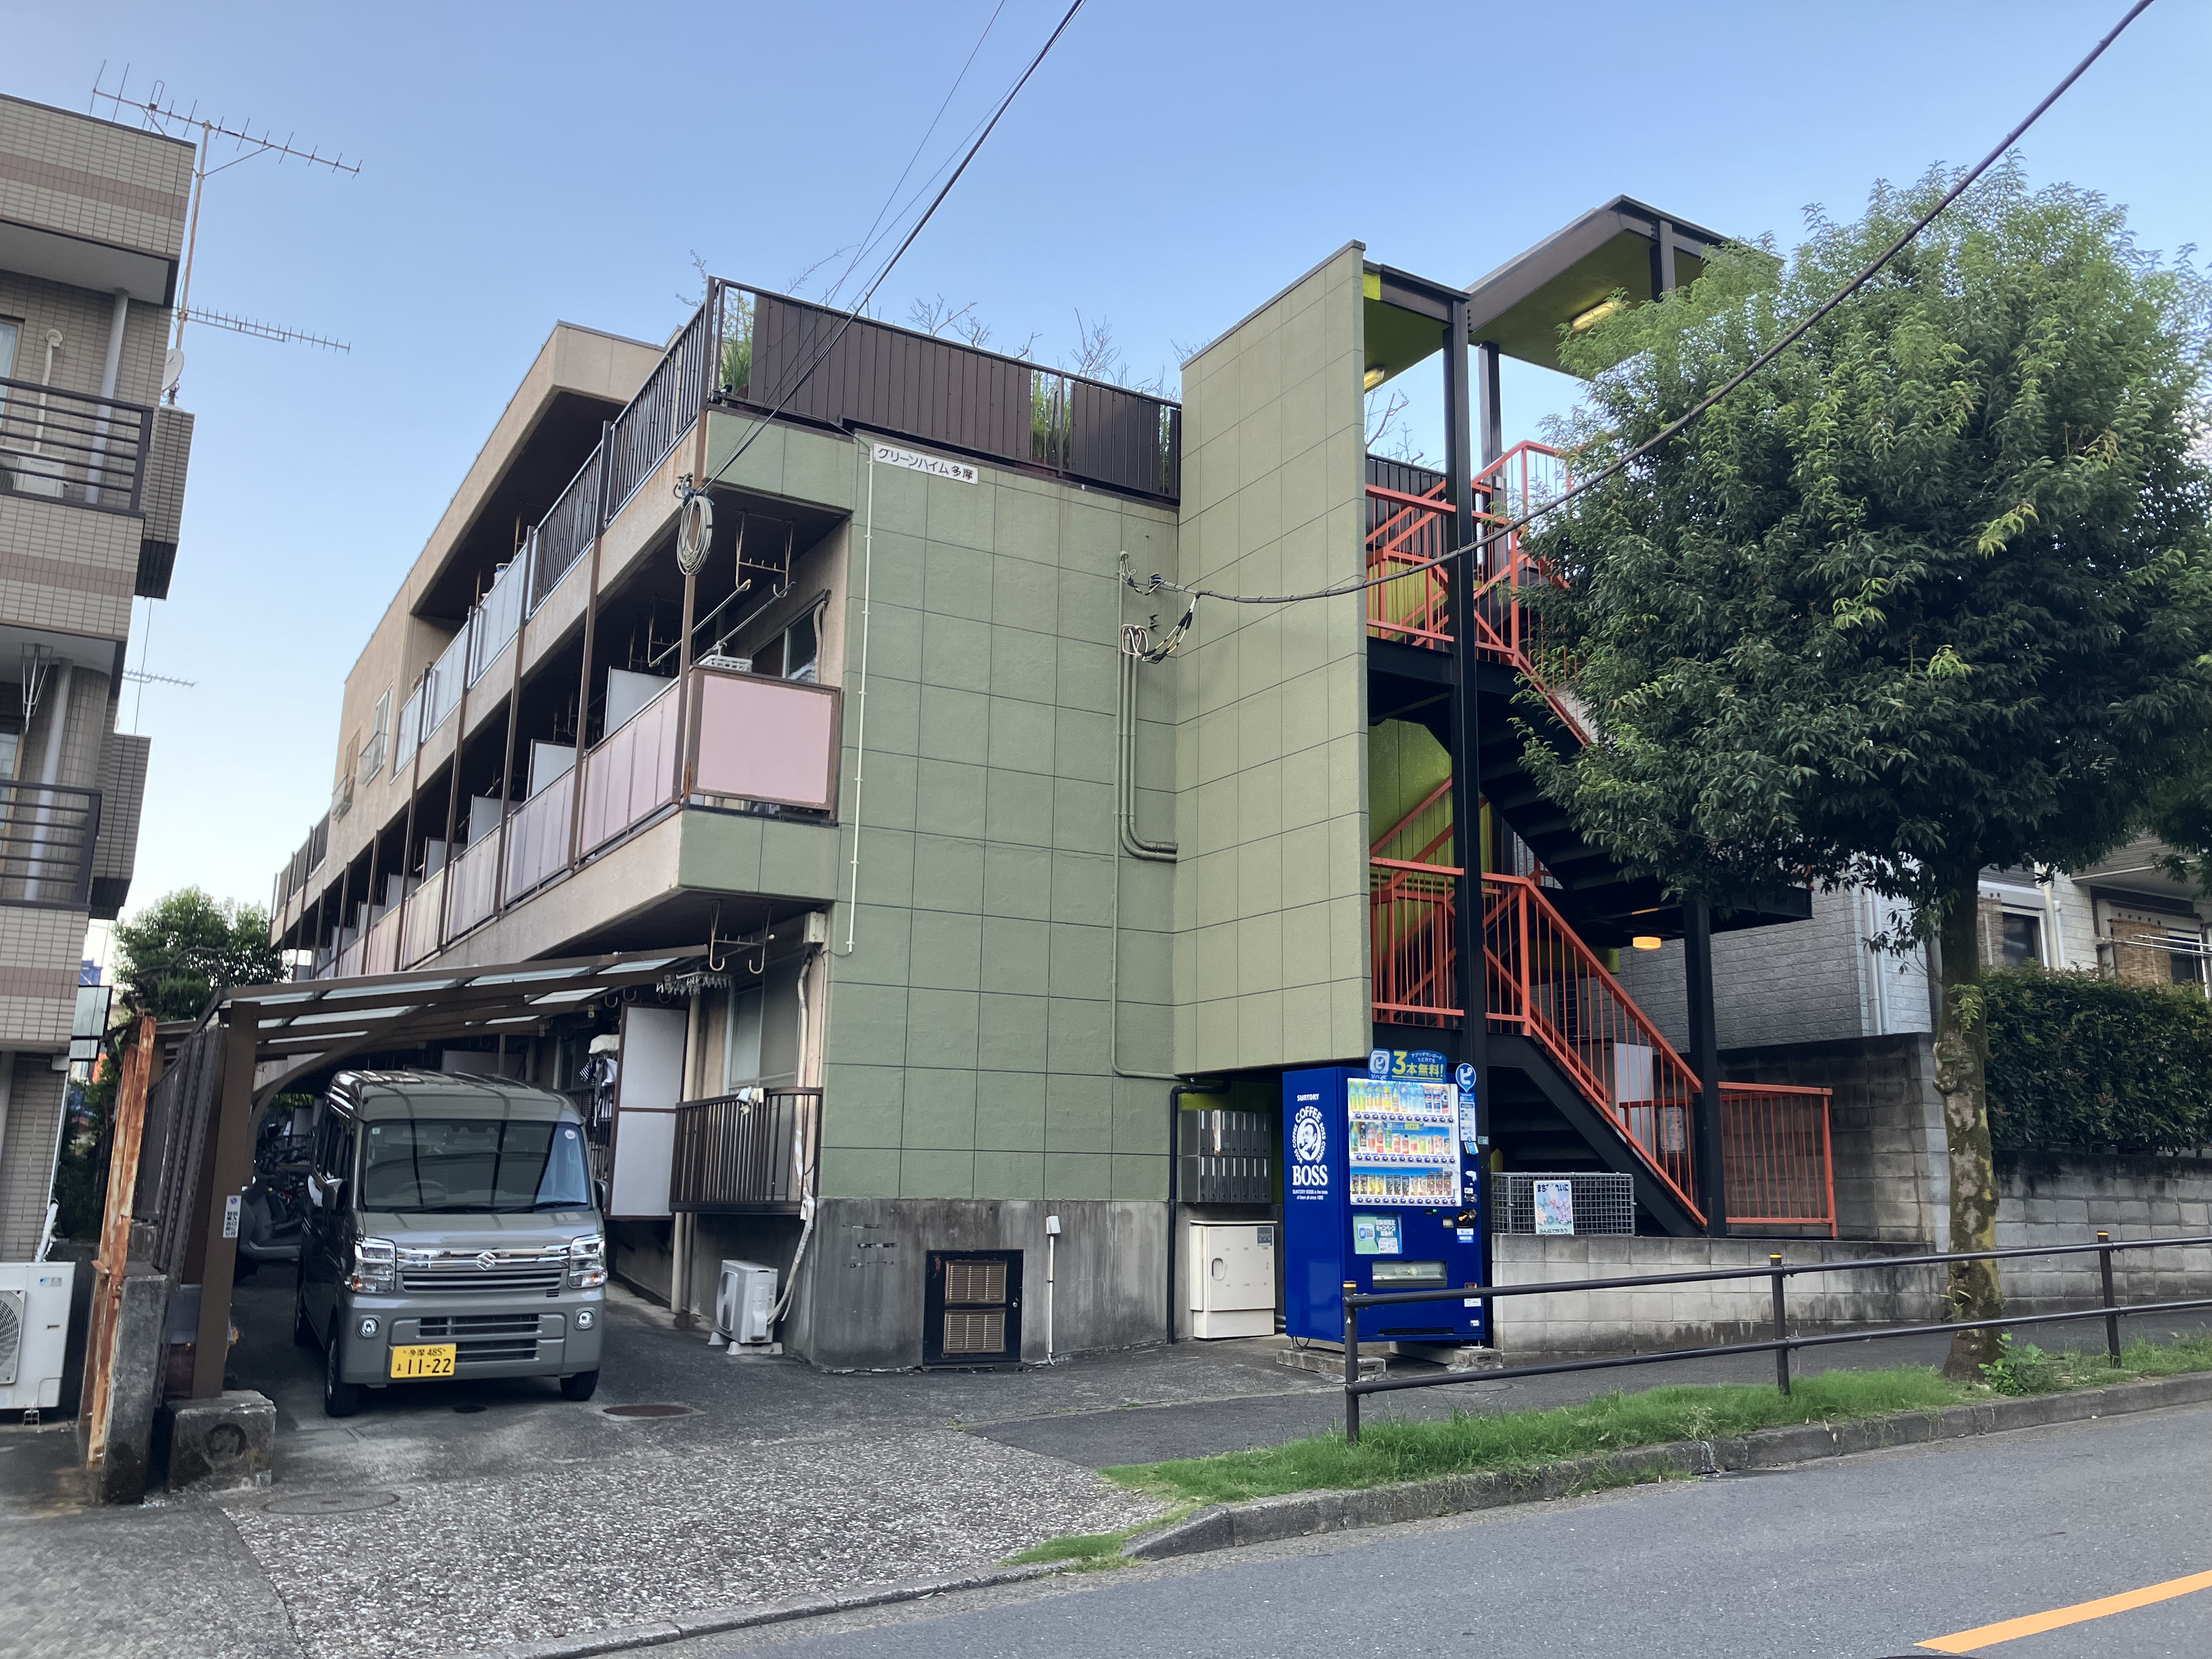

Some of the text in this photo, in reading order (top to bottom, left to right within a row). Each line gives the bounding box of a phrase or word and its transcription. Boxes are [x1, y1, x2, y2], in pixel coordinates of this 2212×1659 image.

[878, 448, 974, 480] グリーンハイム多摩
[1392, 1051, 1444, 1077] 3本無料!
[1460, 1067, 1473, 1085] ピ
[1297, 1093, 1319, 1102] SUNTORY
[1295, 1106, 1323, 1123] COFFEE
[1292, 1165, 1328, 1186] BOSS
[427, 1347, 443, 1357] 485
[408, 1358, 451, 1374] 11-22
